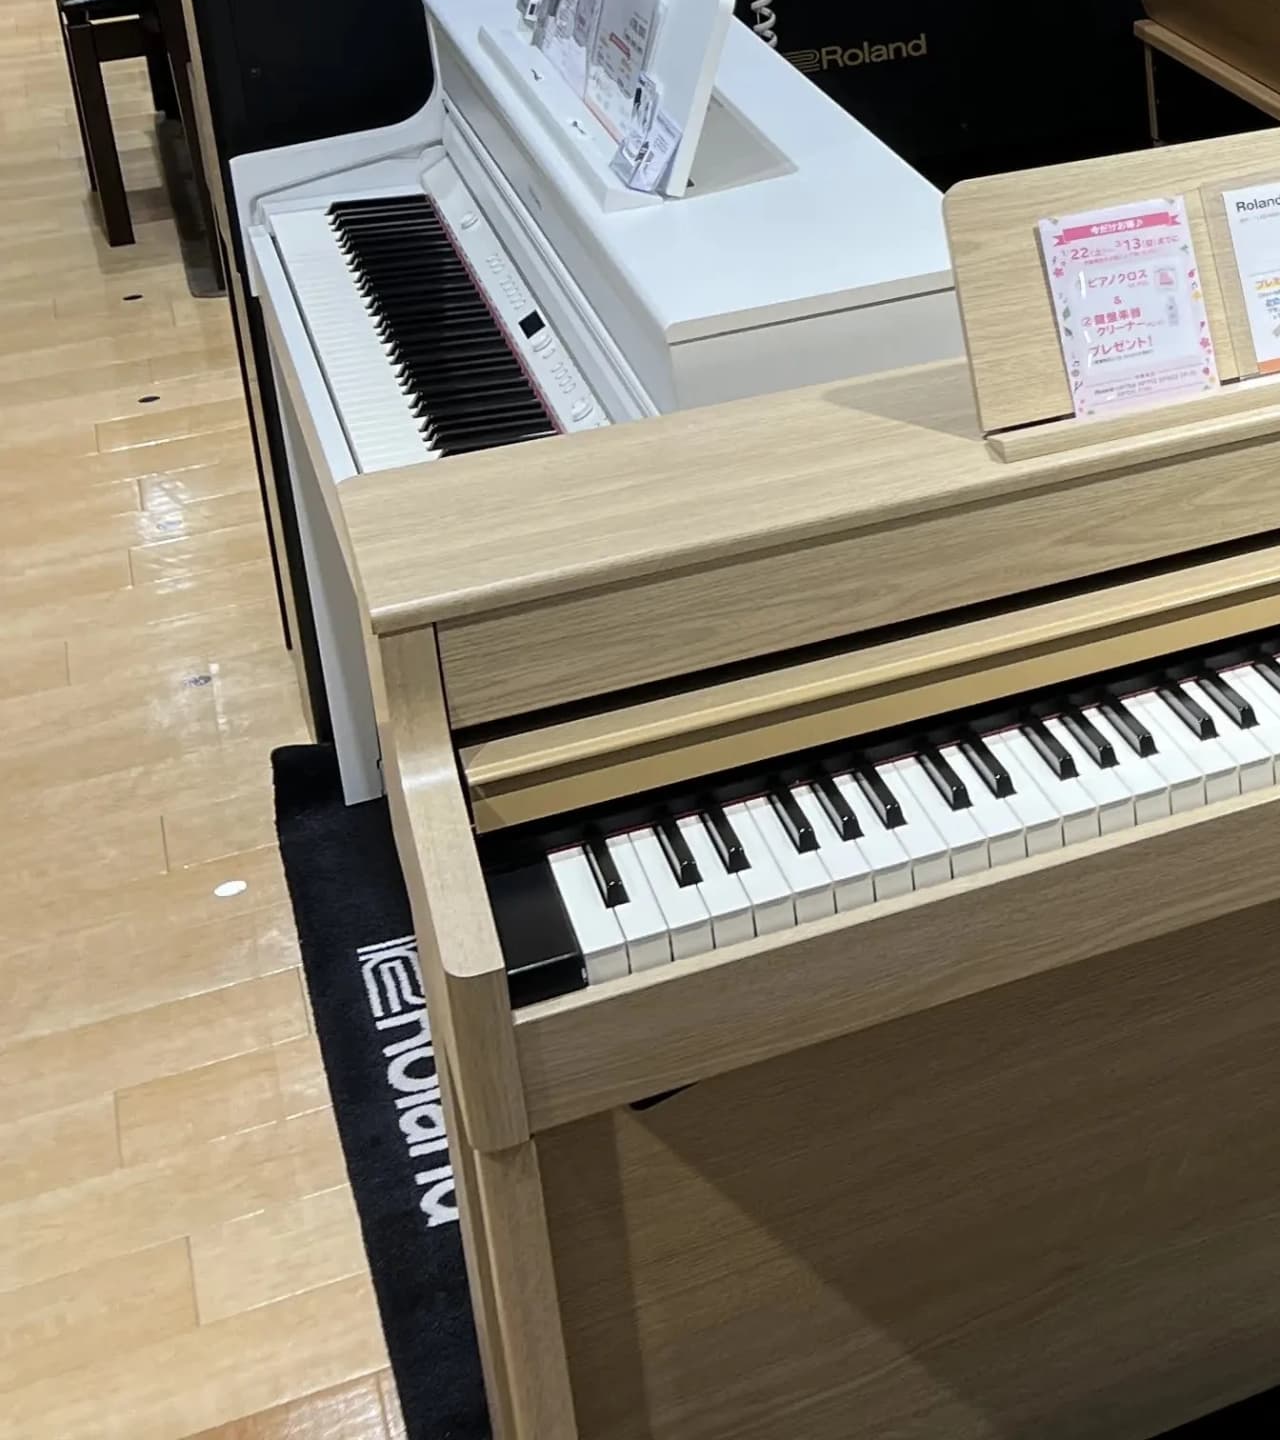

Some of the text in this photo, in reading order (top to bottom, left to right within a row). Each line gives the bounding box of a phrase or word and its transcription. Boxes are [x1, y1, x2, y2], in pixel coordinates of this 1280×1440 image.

[821, 33, 928, 70] Roland
[1088, 270, 1148, 289] ピアノクロス
